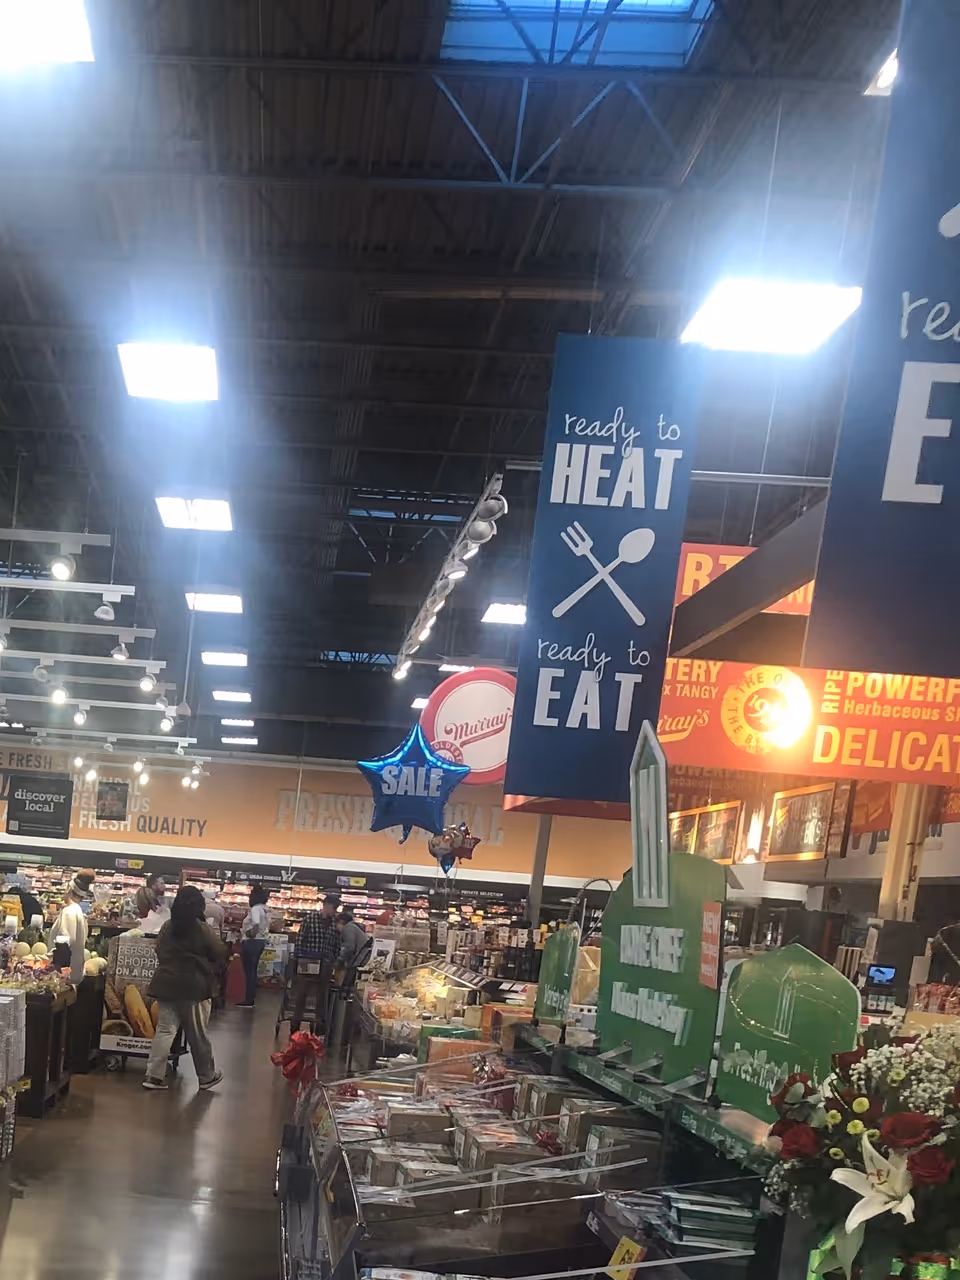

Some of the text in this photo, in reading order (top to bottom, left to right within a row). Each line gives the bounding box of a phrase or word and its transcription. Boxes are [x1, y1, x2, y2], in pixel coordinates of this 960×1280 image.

[901, 290, 960, 341] re
[565, 406, 681, 459] ready to
[550, 442, 683, 510] HEAT
[537, 632, 651, 683] ready to
[533, 667, 643, 732] EAT
[675, 684, 719, 699] TANGY
[821, 670, 844, 713] RIPE
[843, 699, 940, 722] Herbaceous
[8, 752, 52, 769] FRESH
[381, 766, 445, 797] SALE
[14, 789, 66, 803] discover
[24, 801, 54, 812] local
[136, 815, 208, 838] QUALITY
[116, 968, 129, 976] ON
[132, 969, 139, 977] A
